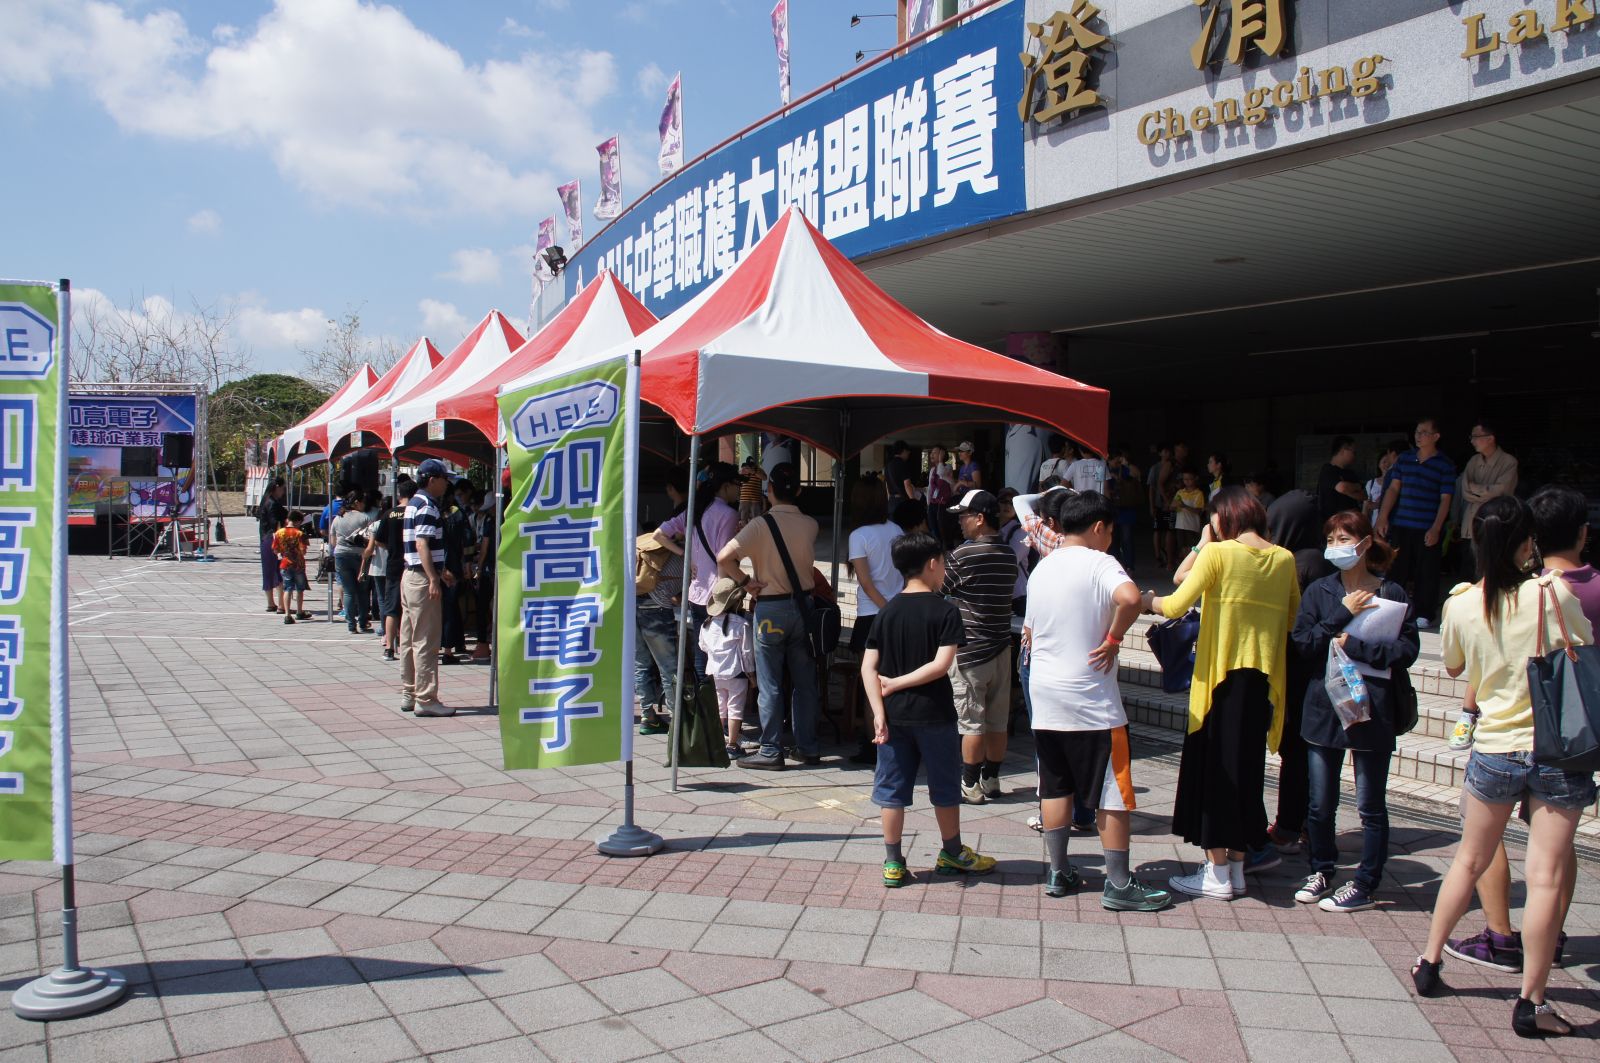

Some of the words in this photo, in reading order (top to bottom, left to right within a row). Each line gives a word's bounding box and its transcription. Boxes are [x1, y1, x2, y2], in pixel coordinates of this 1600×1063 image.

[1137, 54, 1385, 146] Chengcing
[520, 440, 603, 752] 加高電子
